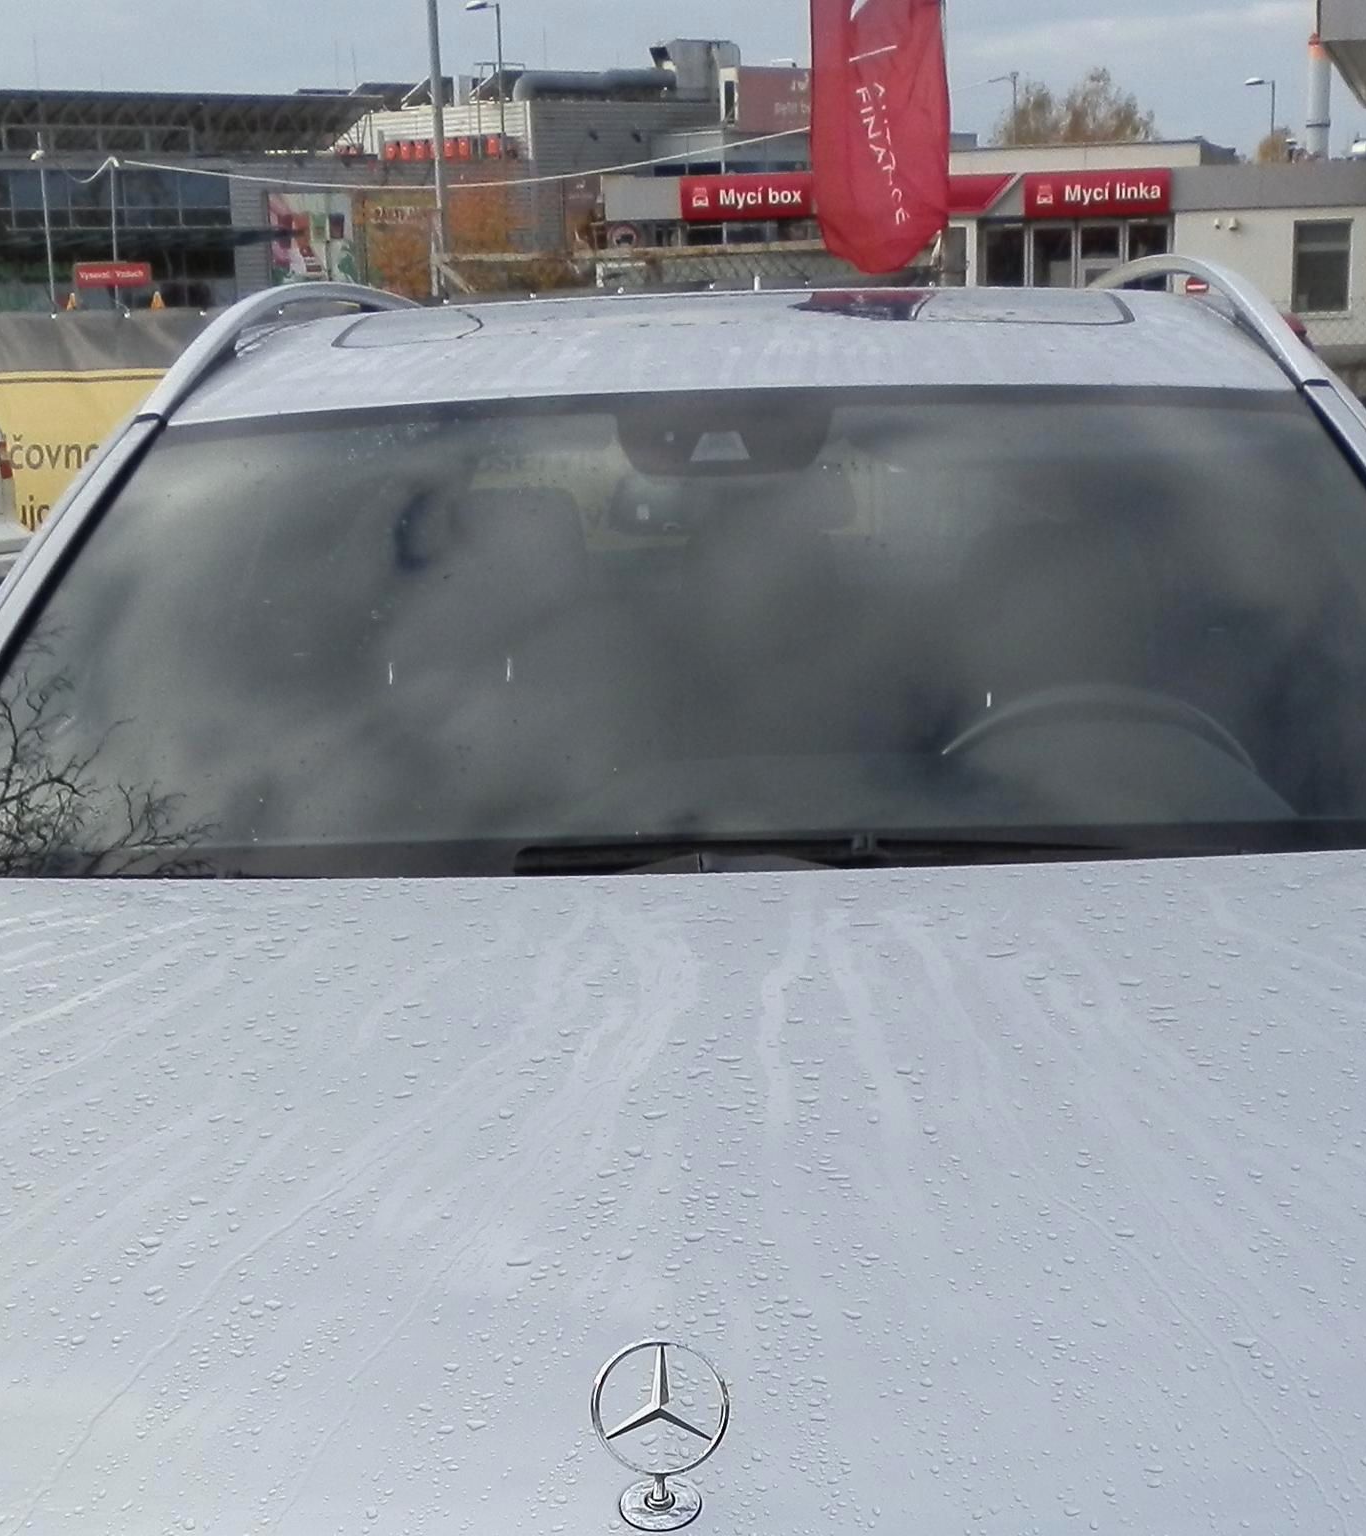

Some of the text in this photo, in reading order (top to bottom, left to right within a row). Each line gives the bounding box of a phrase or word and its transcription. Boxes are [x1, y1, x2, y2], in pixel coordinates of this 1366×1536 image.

[719, 187, 802, 209] Mycí box
[1065, 181, 1161, 206] Mycí linka
